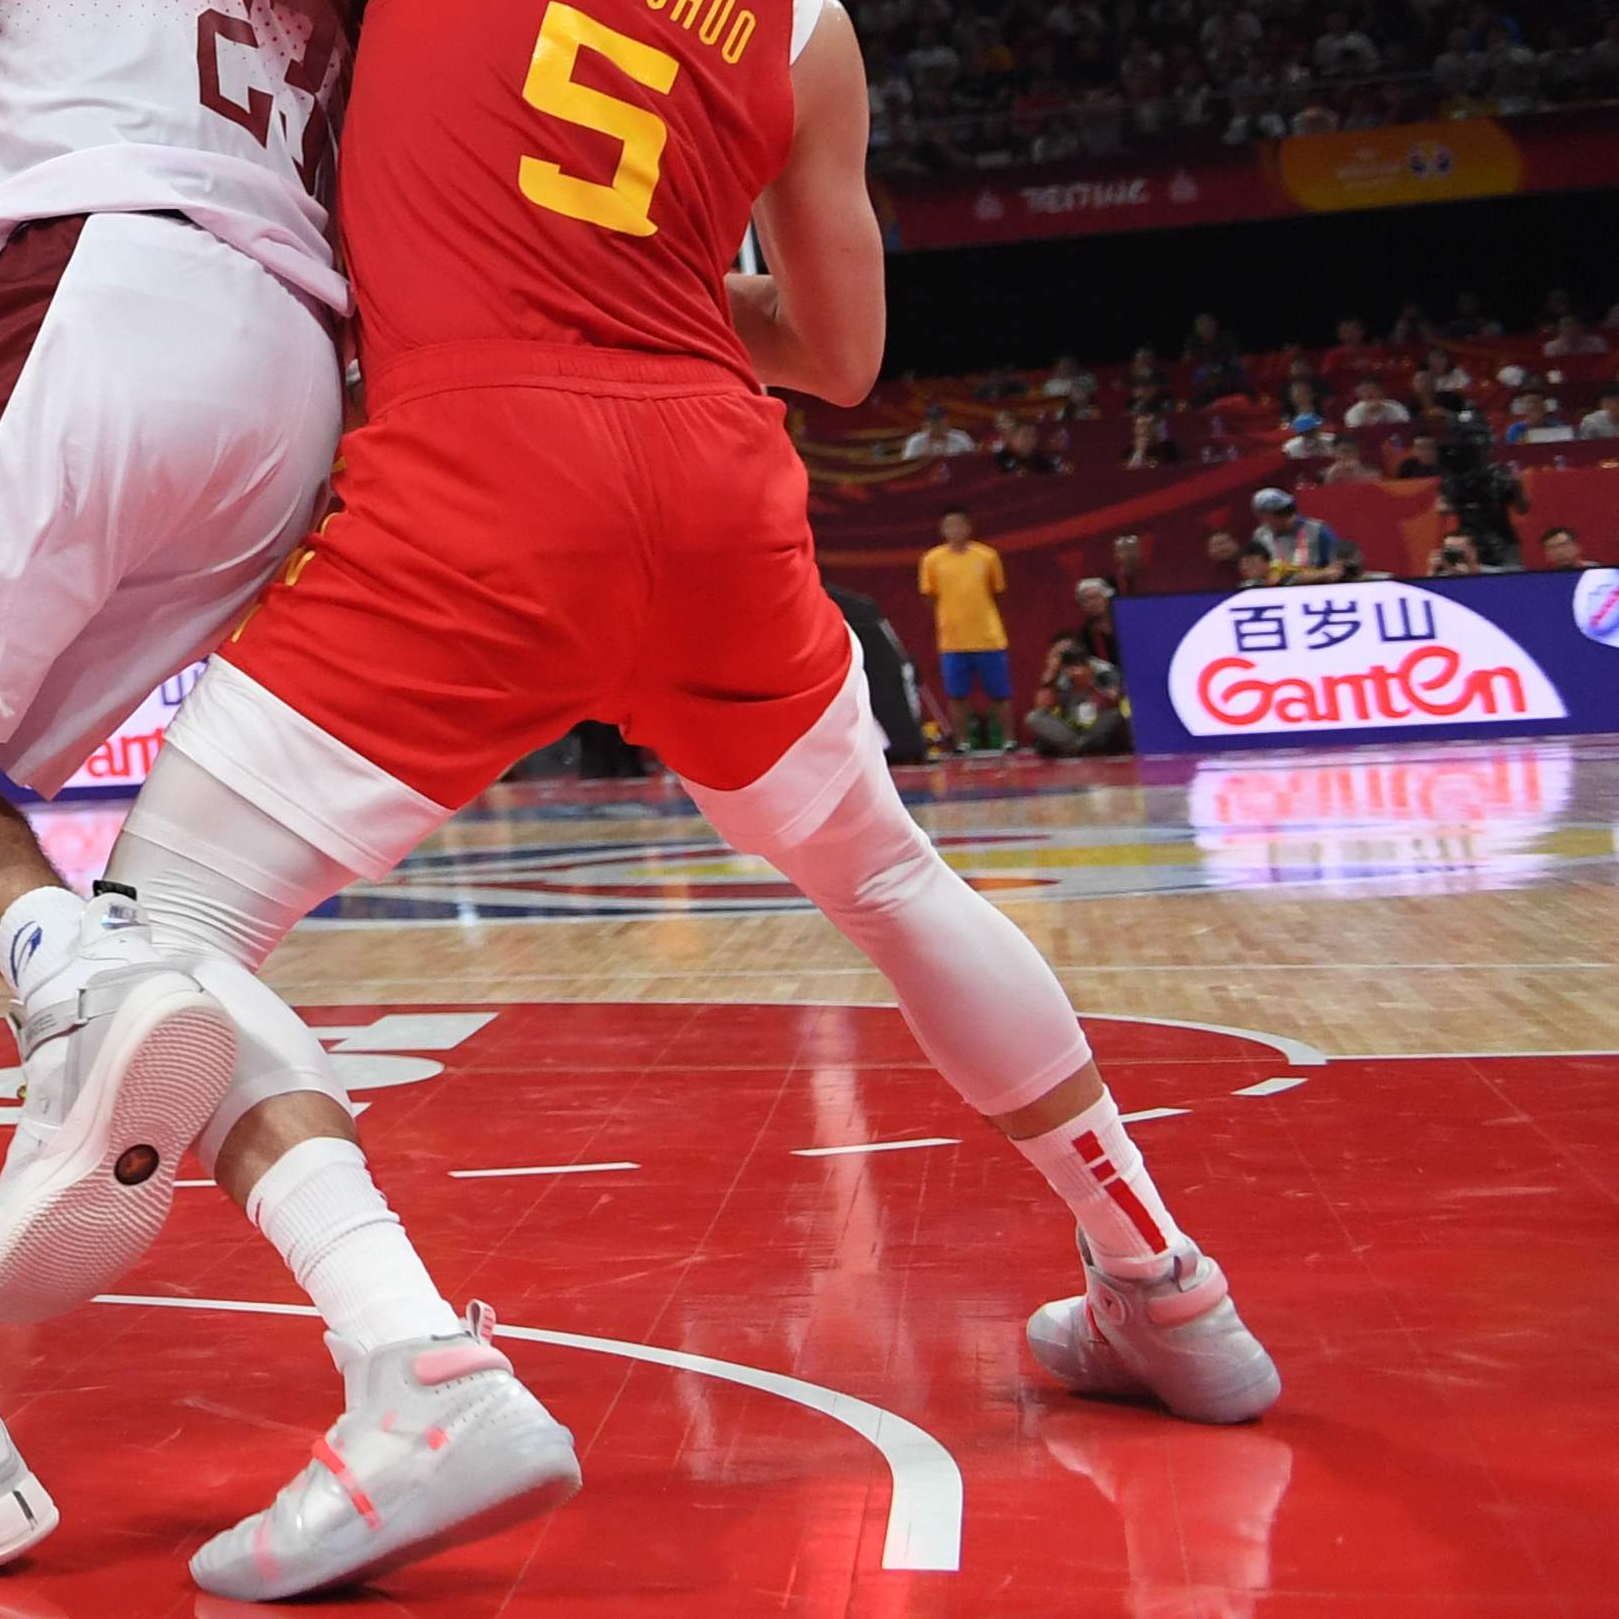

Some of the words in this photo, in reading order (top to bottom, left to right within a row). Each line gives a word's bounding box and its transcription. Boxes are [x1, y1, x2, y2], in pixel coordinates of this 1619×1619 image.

[518, 1, 680, 238] 5
[1229, 596, 1437, 653] 百岁山
